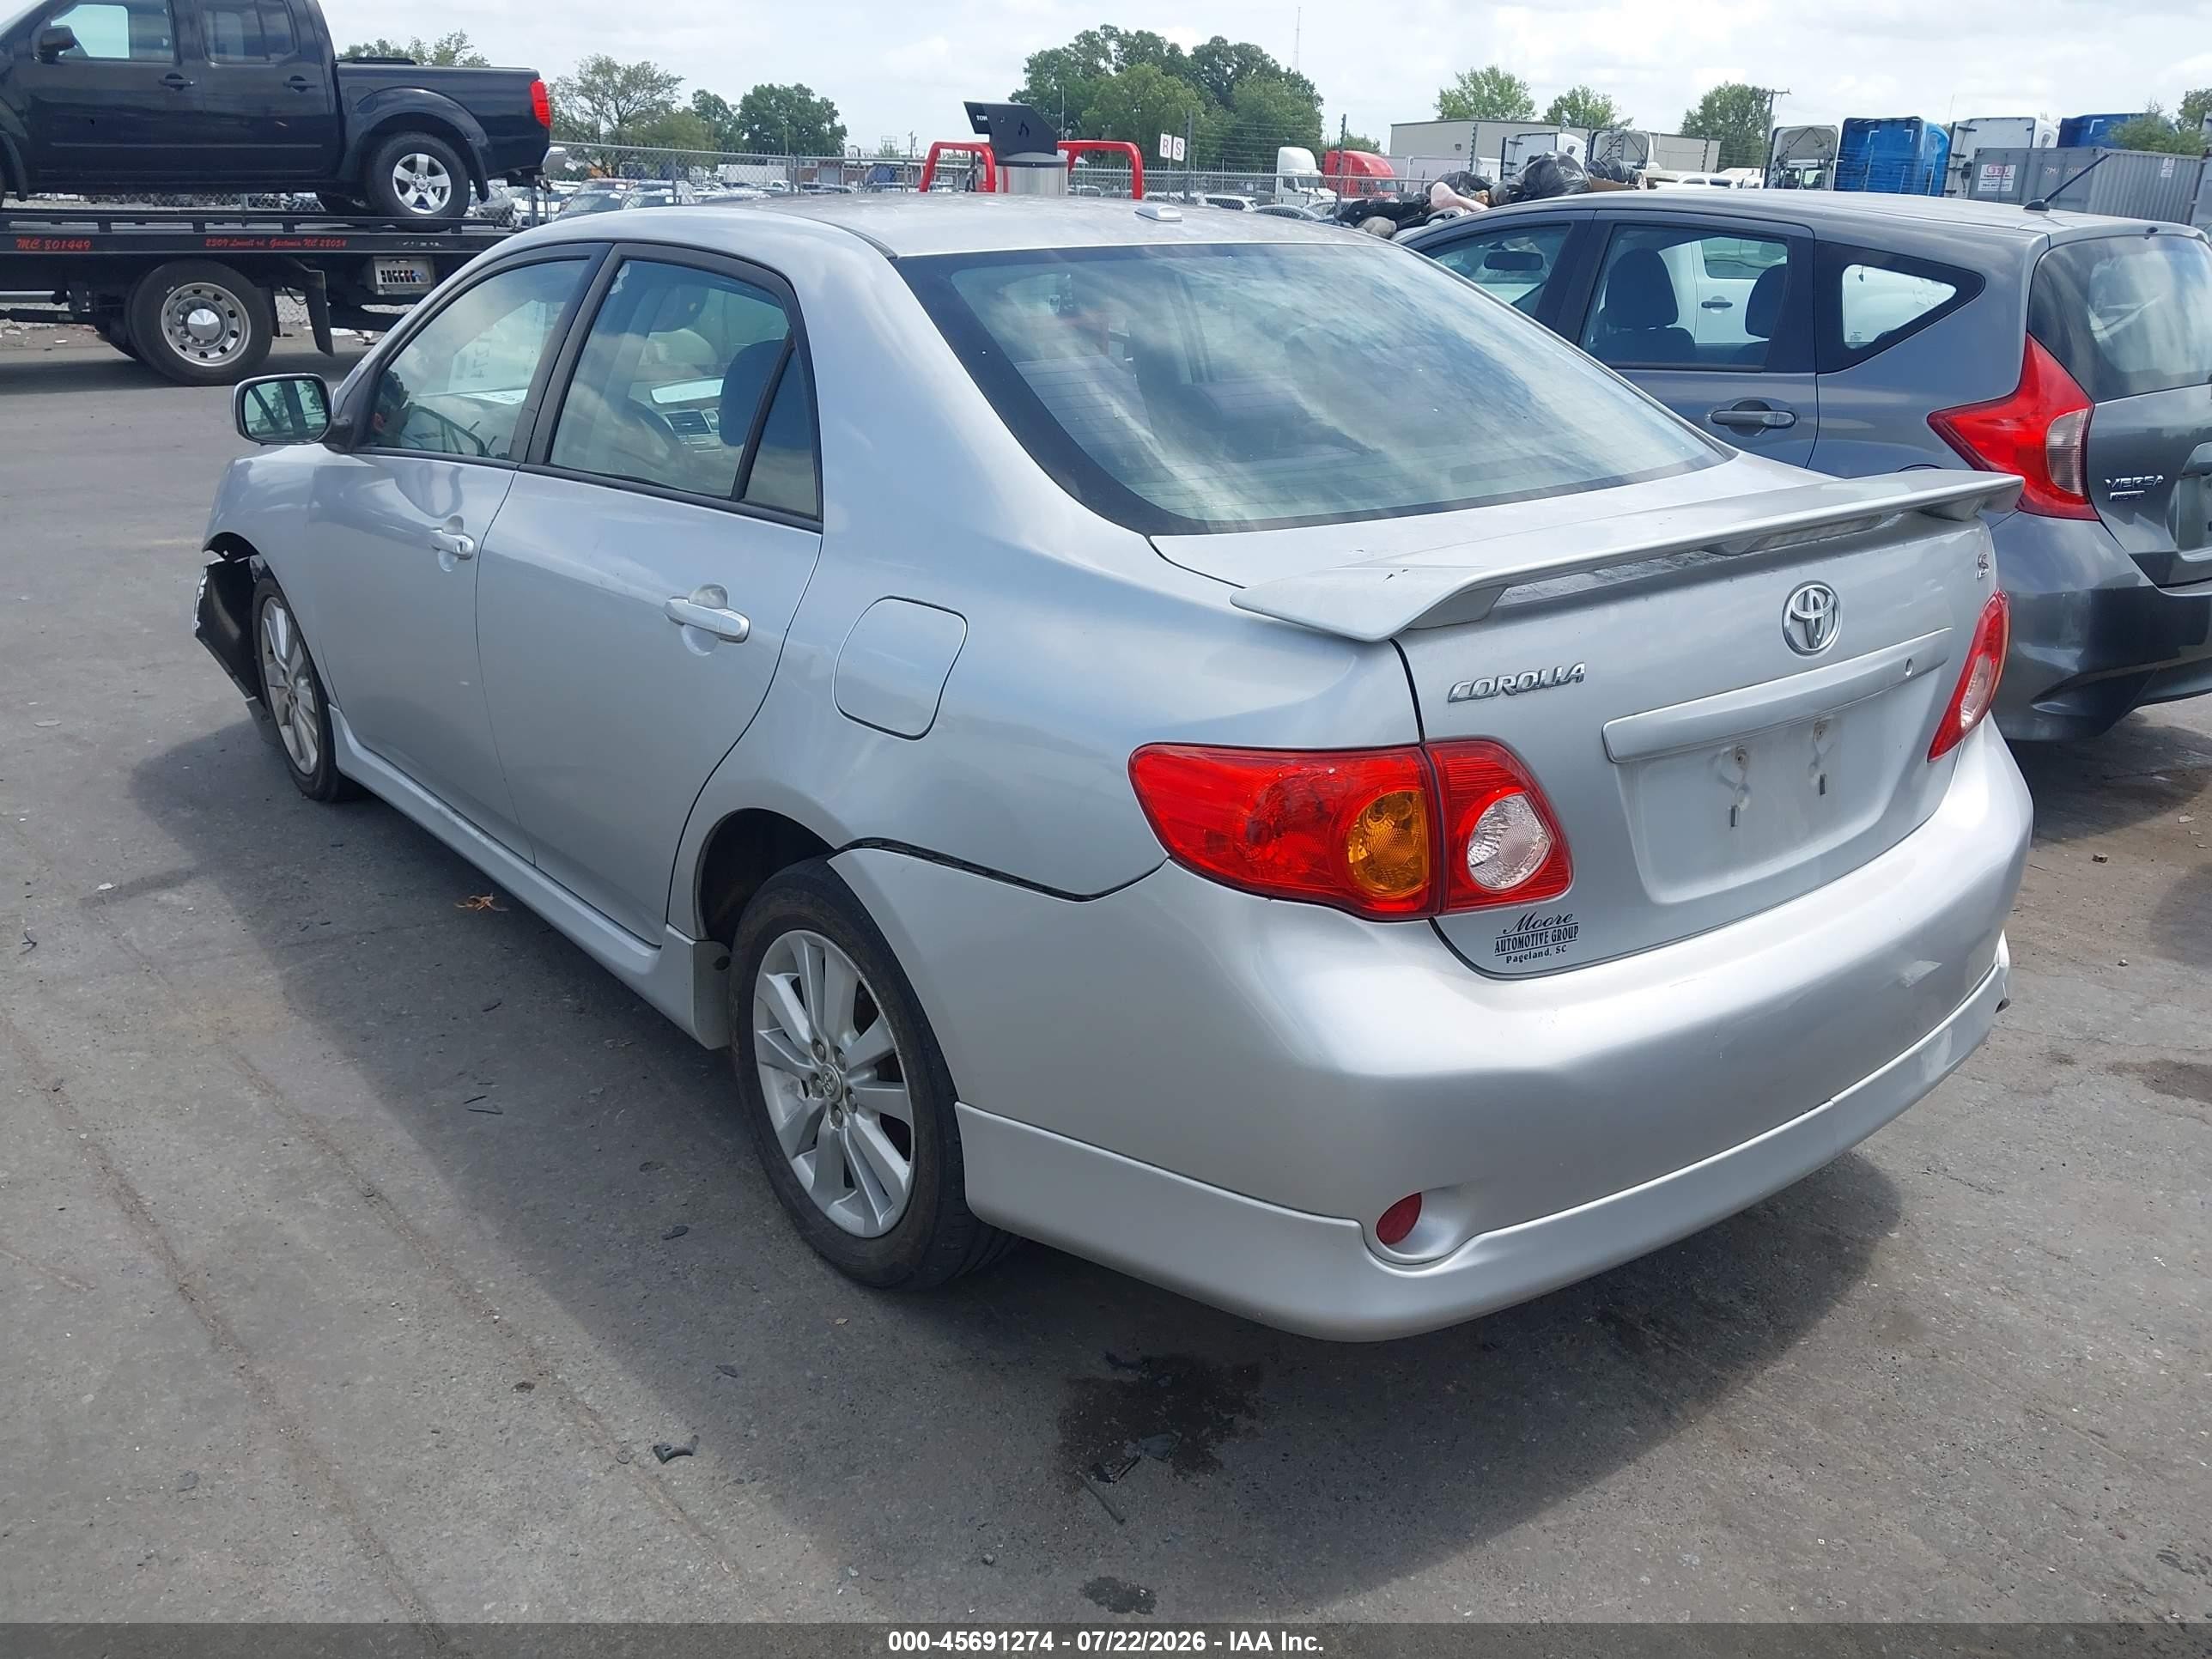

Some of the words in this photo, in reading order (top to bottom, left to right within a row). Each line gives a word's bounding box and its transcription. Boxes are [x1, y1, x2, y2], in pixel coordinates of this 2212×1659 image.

[1162, 137, 1169, 154] R
[1176, 142, 1182, 156] S
[15, 238, 41, 249] MC
[2105, 475, 2164, 489] VERSA
[1977, 552, 1990, 580] S
[1448, 661, 1586, 702] COROLLA
[1503, 911, 1573, 935] Moore
[1494, 931, 1549, 953] AUTOMOTIVE
[1551, 925, 1579, 943] GROUP
[1506, 948, 1552, 963] Pageland,
[1555, 945, 1567, 954] SC
